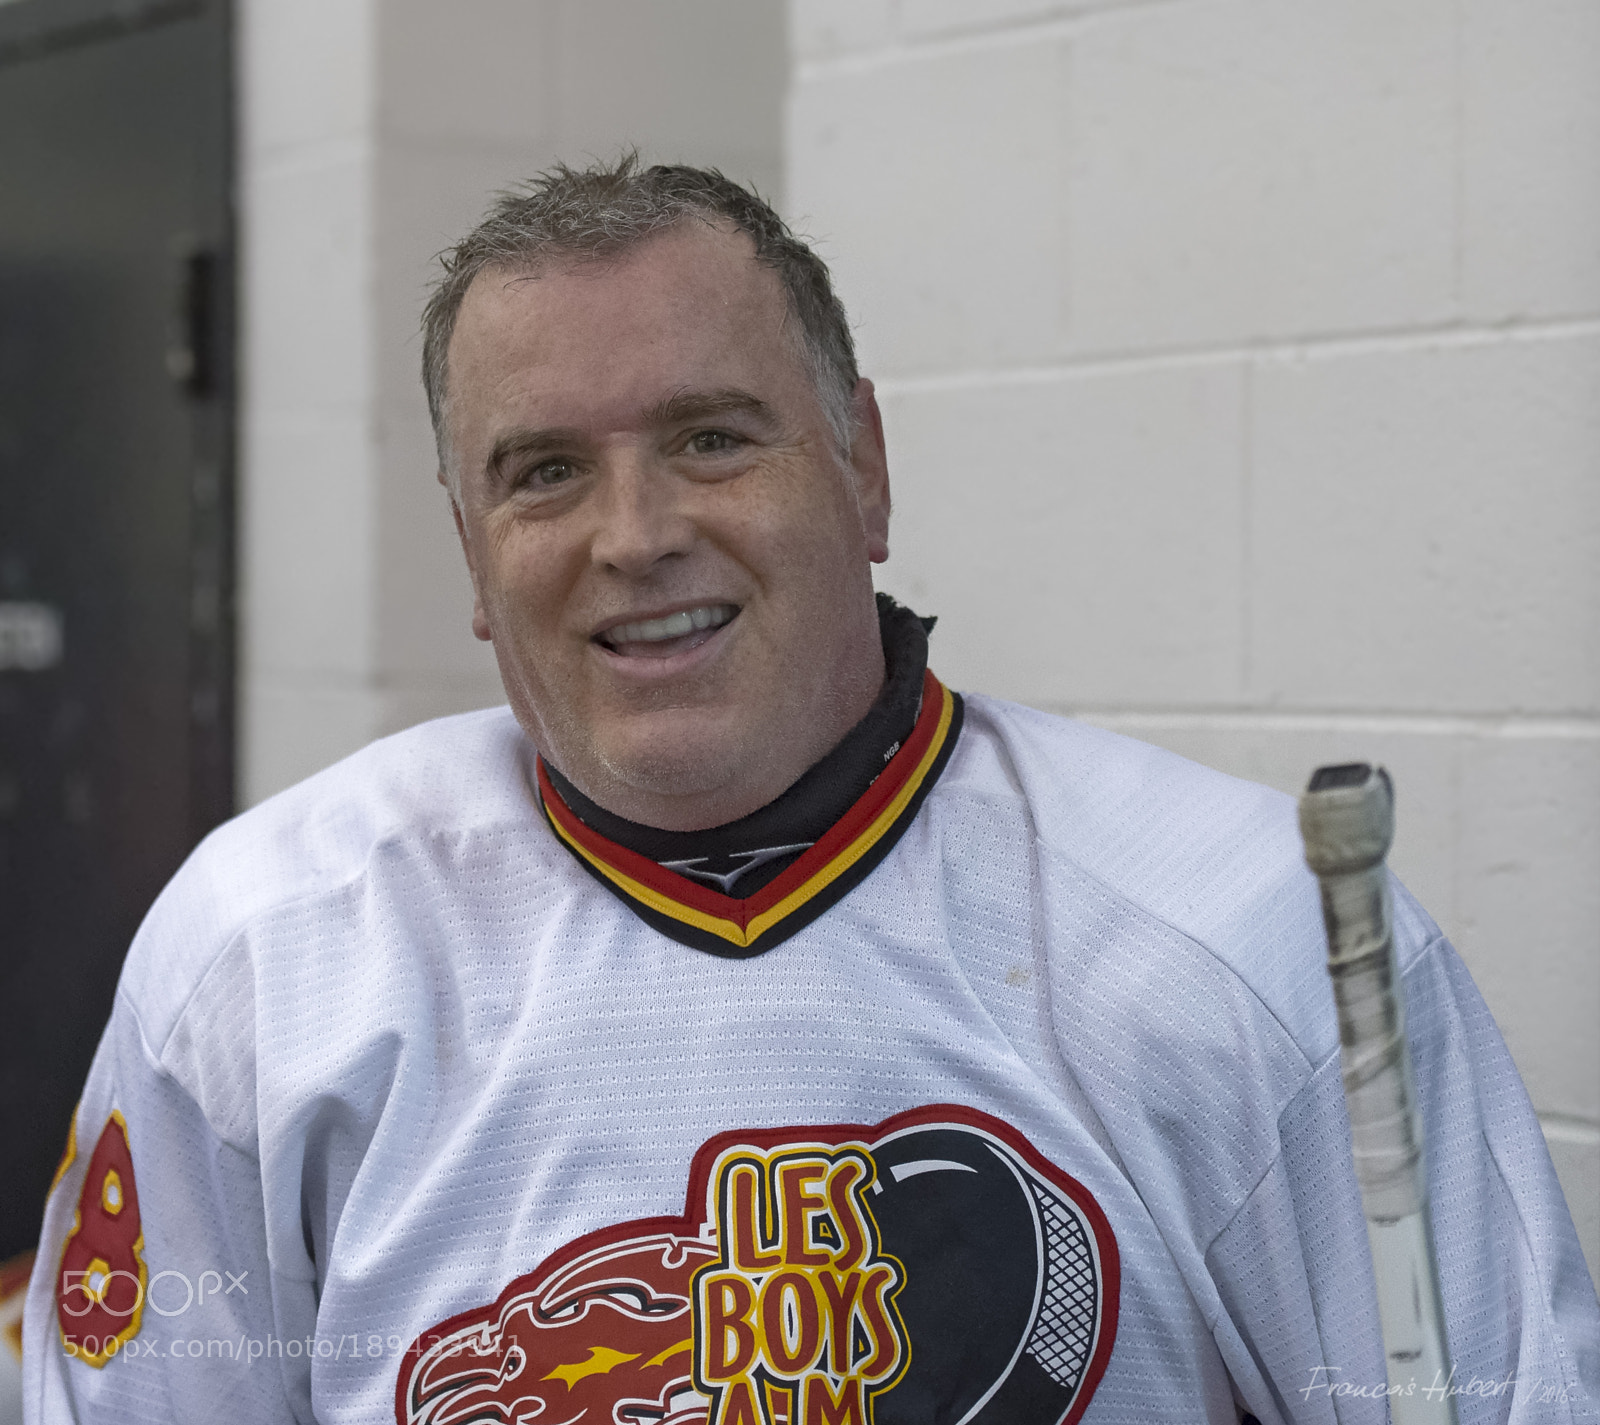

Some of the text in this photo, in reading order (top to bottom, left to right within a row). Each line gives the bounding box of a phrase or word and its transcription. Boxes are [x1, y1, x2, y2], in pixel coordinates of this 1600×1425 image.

[883, 741, 900, 762] NGB
[730, 1161, 870, 1271] LES
[705, 1264, 898, 1379] BOYS
